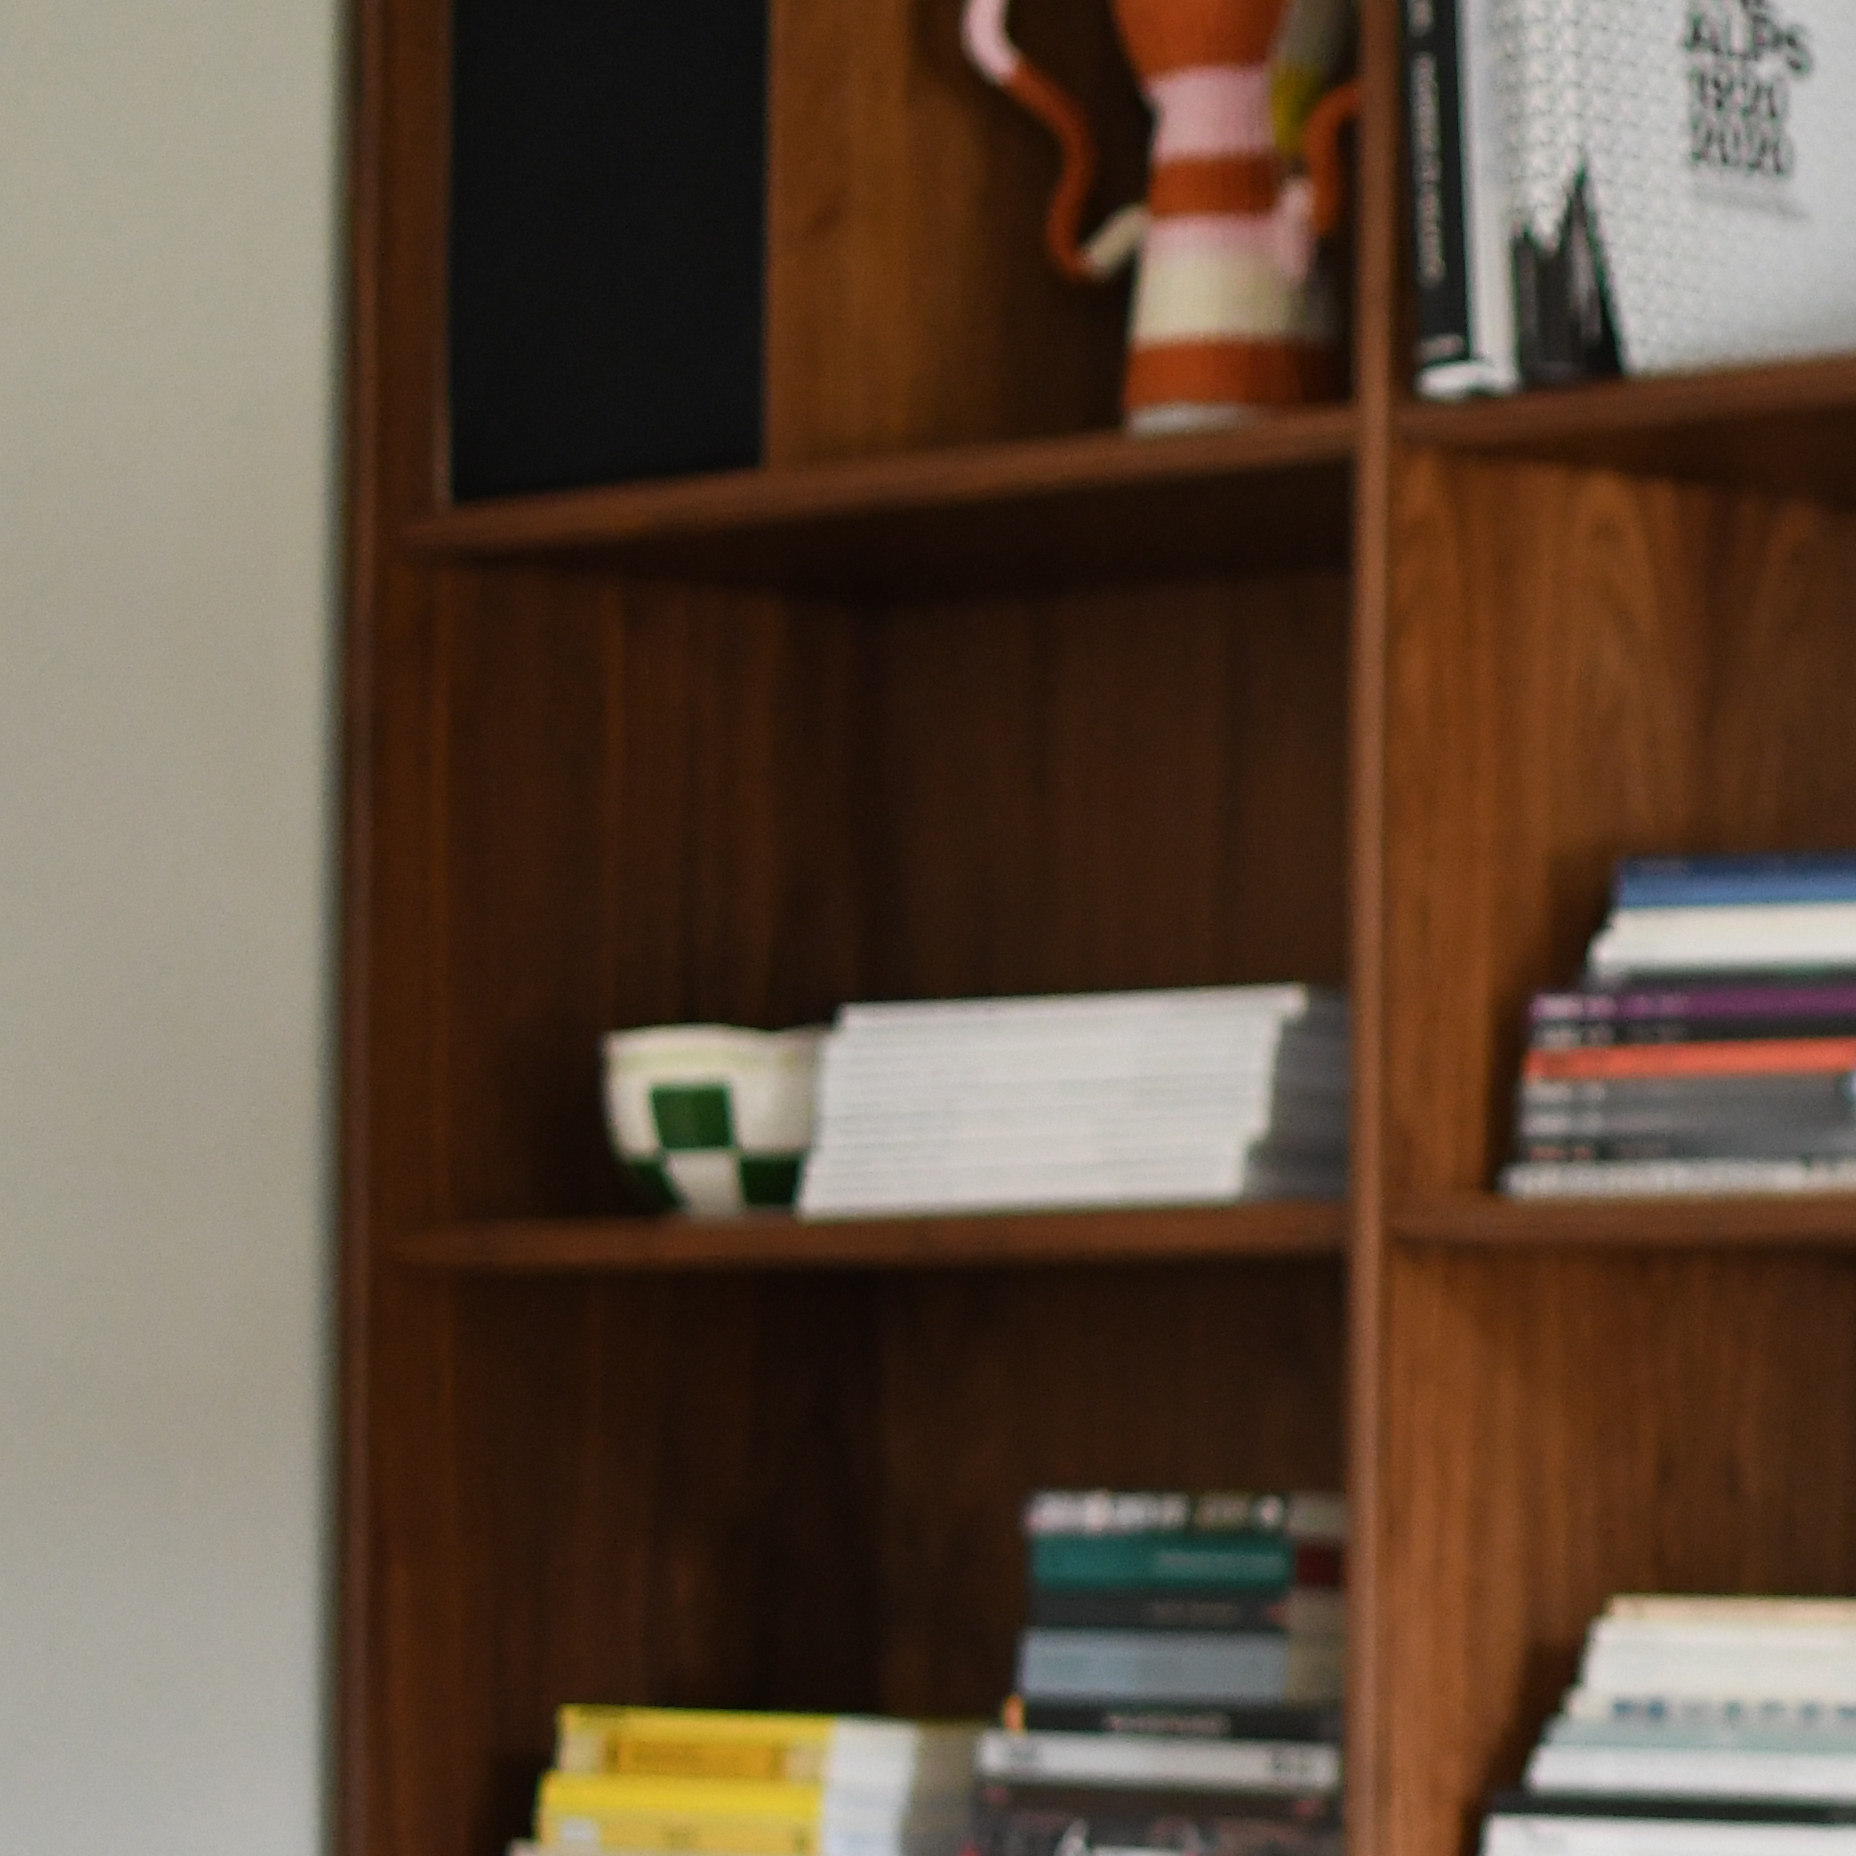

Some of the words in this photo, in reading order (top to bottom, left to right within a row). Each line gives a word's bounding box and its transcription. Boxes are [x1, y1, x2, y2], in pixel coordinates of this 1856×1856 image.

[1684, 9, 1812, 76] ALPS
[1688, 66, 1788, 121] 1920
[1689, 114, 1795, 176] 2020
